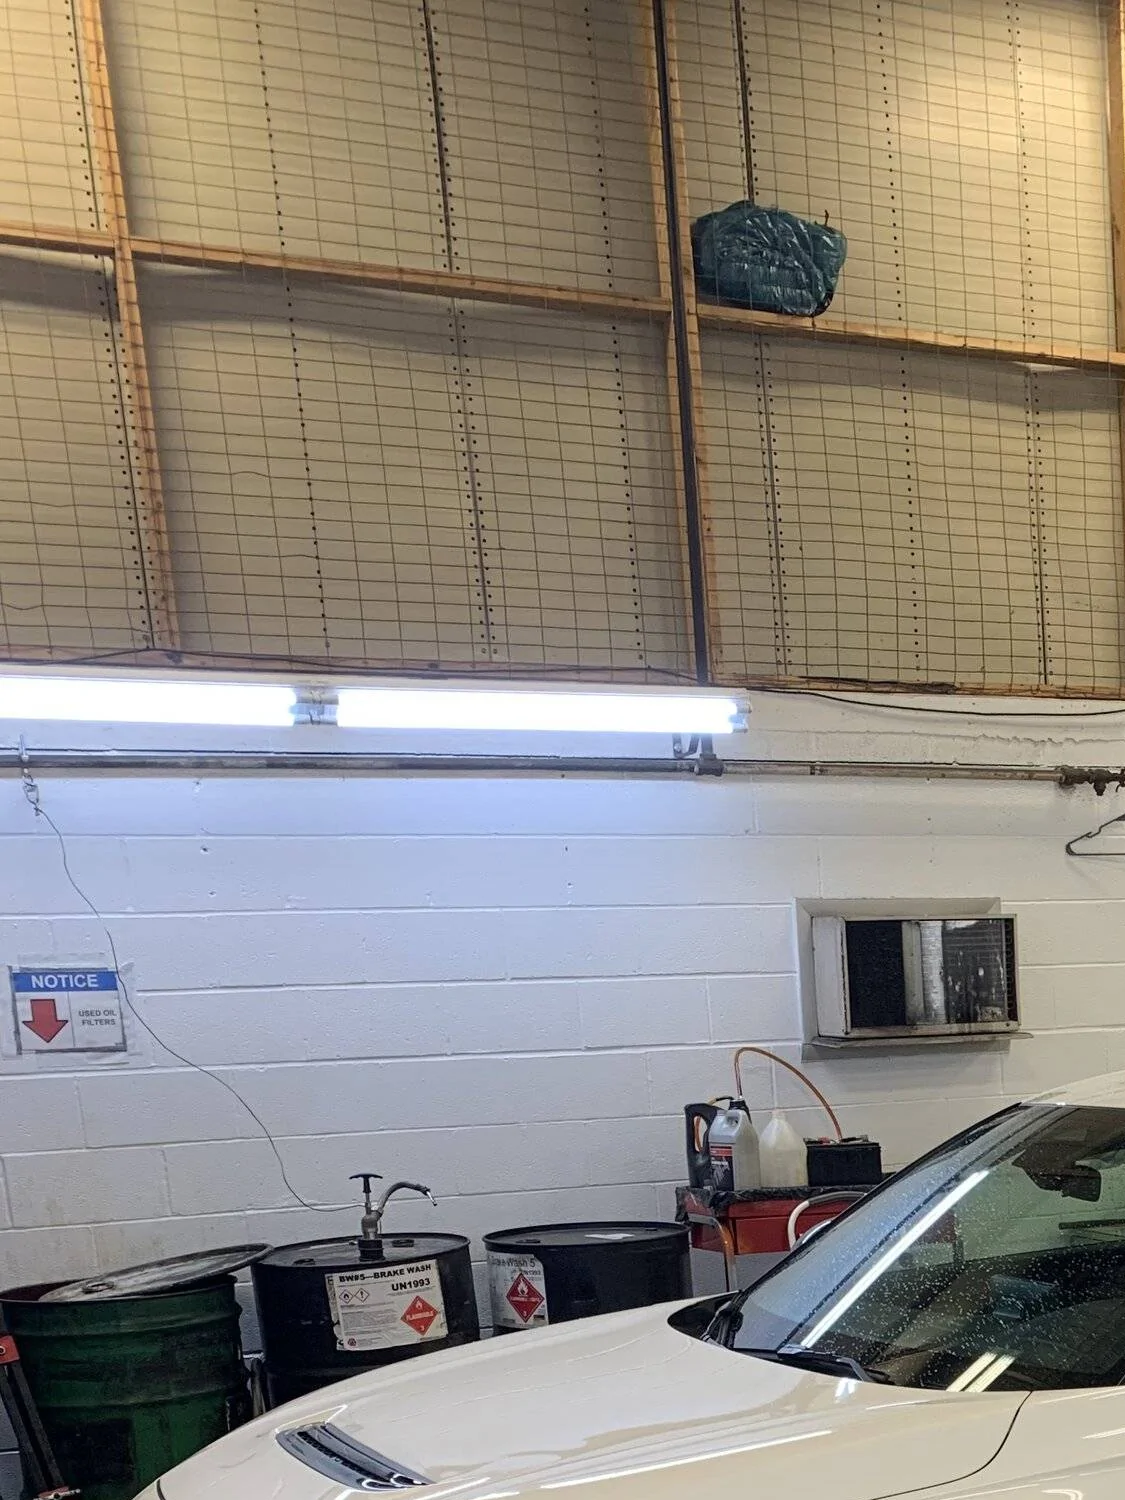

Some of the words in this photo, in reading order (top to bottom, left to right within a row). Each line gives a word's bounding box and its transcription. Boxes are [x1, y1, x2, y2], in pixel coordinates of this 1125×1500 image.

[31, 974, 99, 988] NOTICE
[82, 1018, 116, 1026] FILTERS
[530, 1257, 536, 1268] 5
[407, 1264, 432, 1274] WASH
[391, 1278, 431, 1291] UN1993
